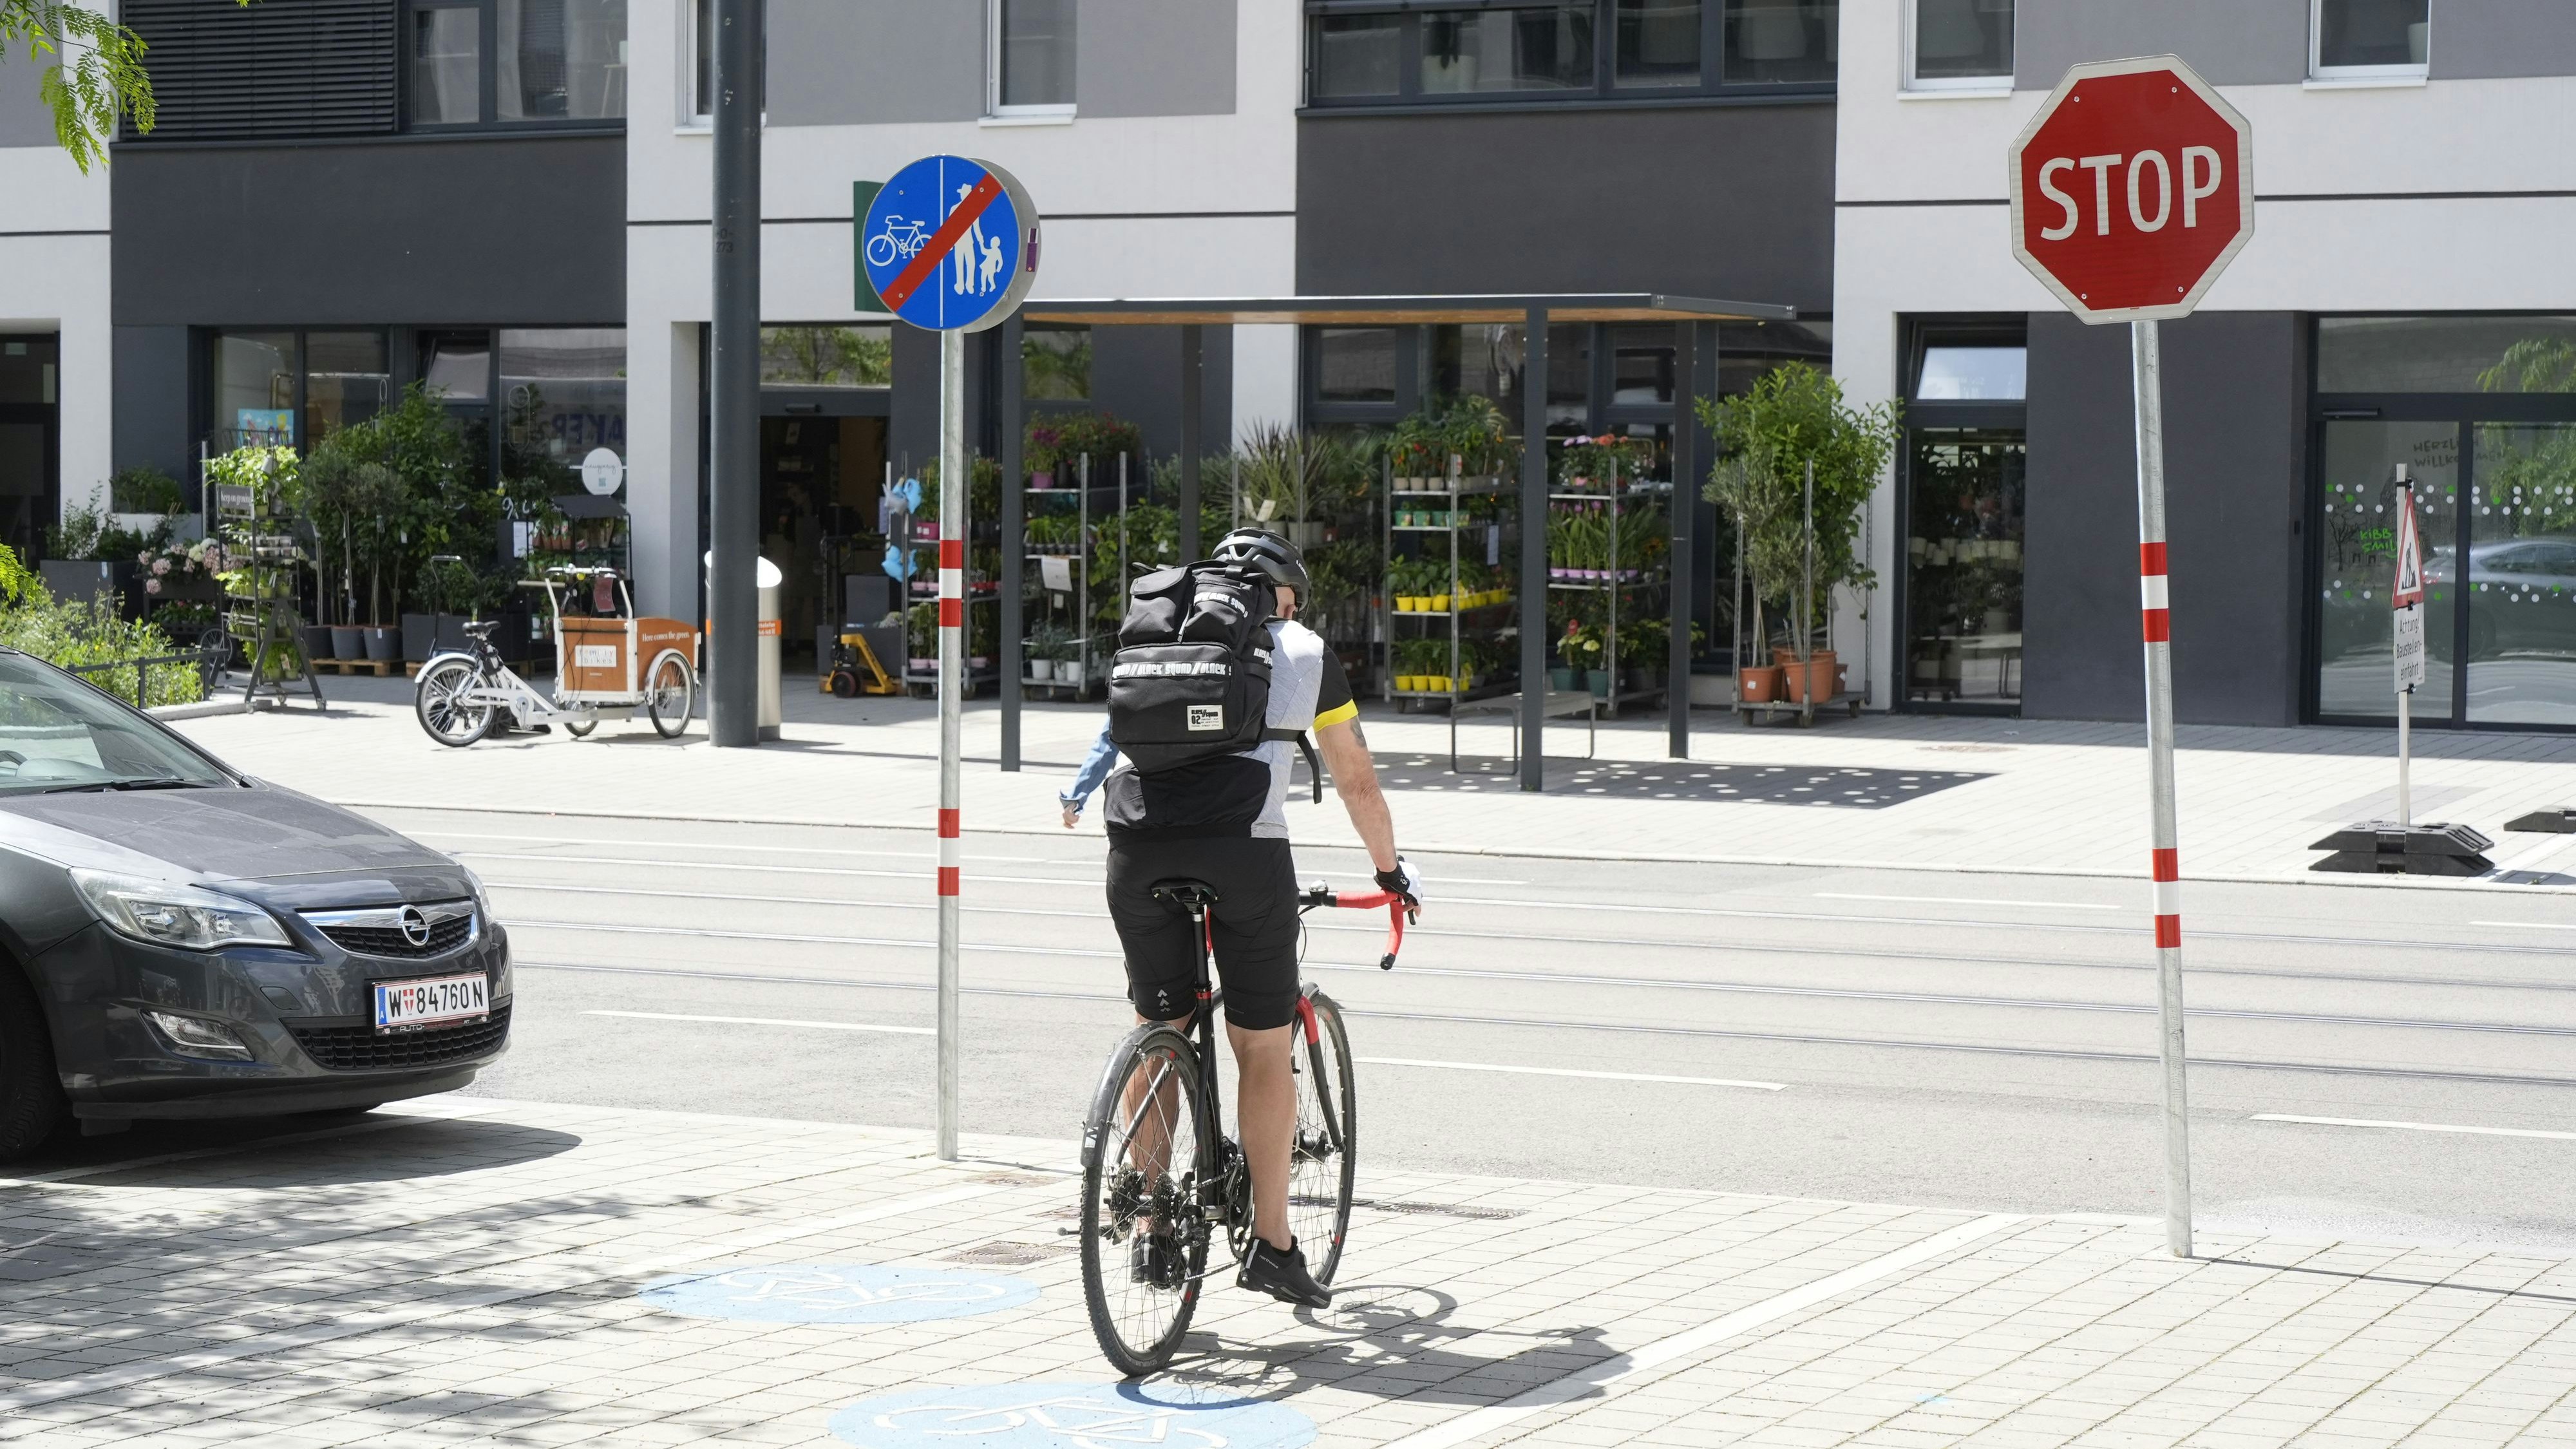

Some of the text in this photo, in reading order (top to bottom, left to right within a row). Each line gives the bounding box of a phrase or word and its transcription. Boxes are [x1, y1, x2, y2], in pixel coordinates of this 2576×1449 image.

[2038, 146, 2222, 242] STOP
[2400, 615, 2420, 634] Achtung!
[642, 634, 654, 642] Here
[654, 633, 668, 641] comes
[668, 631, 676, 639] the
[2396, 639, 2422, 659] Baustellen-
[2400, 661, 2419, 681] einfahrt
[1191, 715, 1201, 724] 02
[388, 990, 401, 1018] W
[379, 1010, 384, 1019] A
